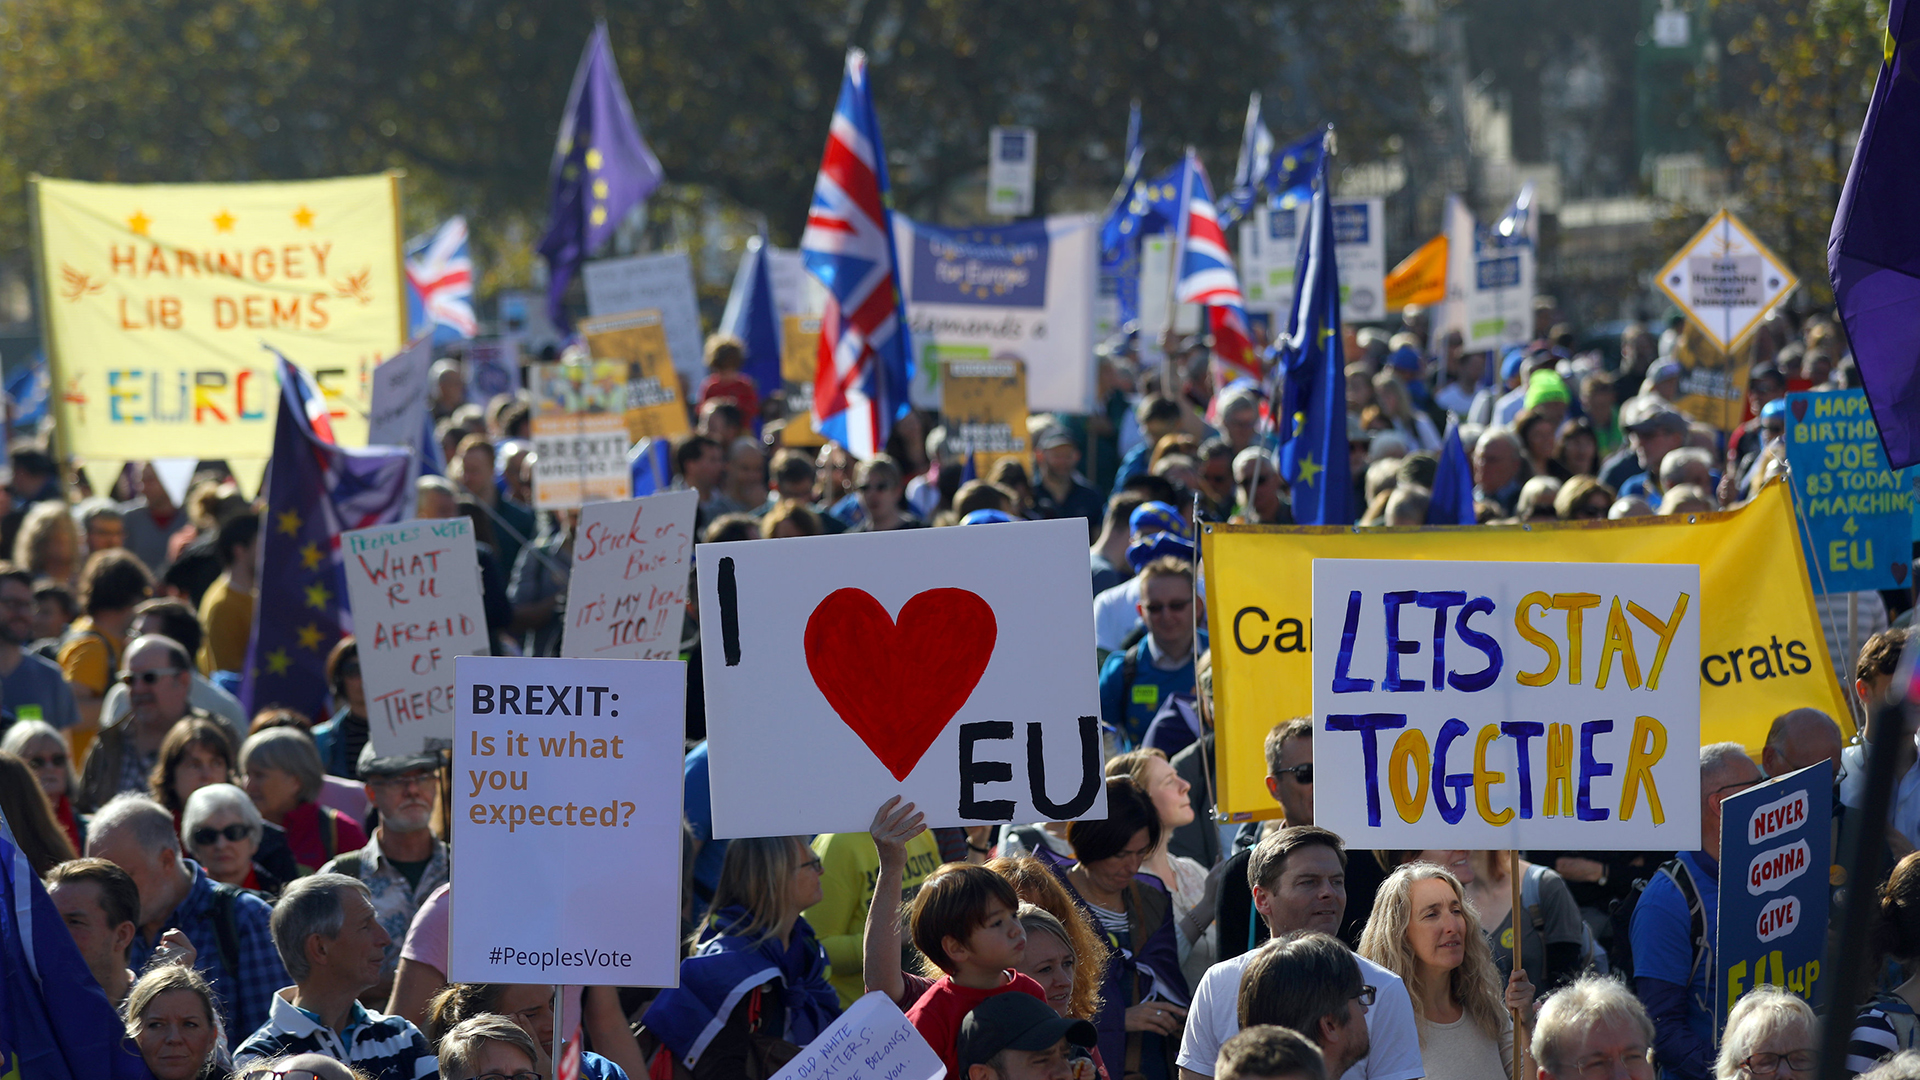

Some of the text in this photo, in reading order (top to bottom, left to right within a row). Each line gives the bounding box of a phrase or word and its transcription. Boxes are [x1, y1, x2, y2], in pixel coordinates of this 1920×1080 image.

[111, 242, 333, 281] HARINGEY
[1693, 273, 1758, 287] Hampshire
[120, 294, 330, 330] LIB DEMS
[1693, 297, 1758, 308] Democrats
[1814, 396, 1869, 418] HAPP
[1794, 419, 1879, 443] BIRTHD
[1824, 443, 1878, 470] JOE
[1806, 470, 1904, 496] 83 TODAY
[1809, 491, 1914, 518] MARCHING
[350, 521, 470, 554] PEOPLES VOTE
[578, 506, 675, 562] Stick or
[1842, 516, 1859, 537] 4
[358, 549, 450, 585] WHAT
[1829, 539, 1875, 572] EU
[387, 583, 410, 608] R
[576, 593, 606, 628] IT'S
[613, 592, 642, 621] MY
[717, 556, 741, 666] I
[374, 613, 475, 650] AFRAID
[1233, 606, 1812, 687] Ca crats
[1332, 589, 1690, 693] LETS STAY
[411, 648, 442, 675] OF
[472, 684, 620, 717] BREXIT:
[471, 730, 624, 759] Is it what
[469, 769, 528, 797] you
[957, 715, 1101, 822] EU
[1324, 712, 1667, 828] TOGETHER
[469, 800, 636, 833] expected?
[1754, 799, 1804, 839] NEVER
[1751, 847, 1805, 888] GONNA
[1759, 901, 1793, 937] GIVE
[489, 947, 632, 971] #PeoplesVote
[1787, 959, 1820, 1000] up
[798, 1023, 852, 1078] OLD WHITE
[864, 1024, 911, 1070] BELONGS
